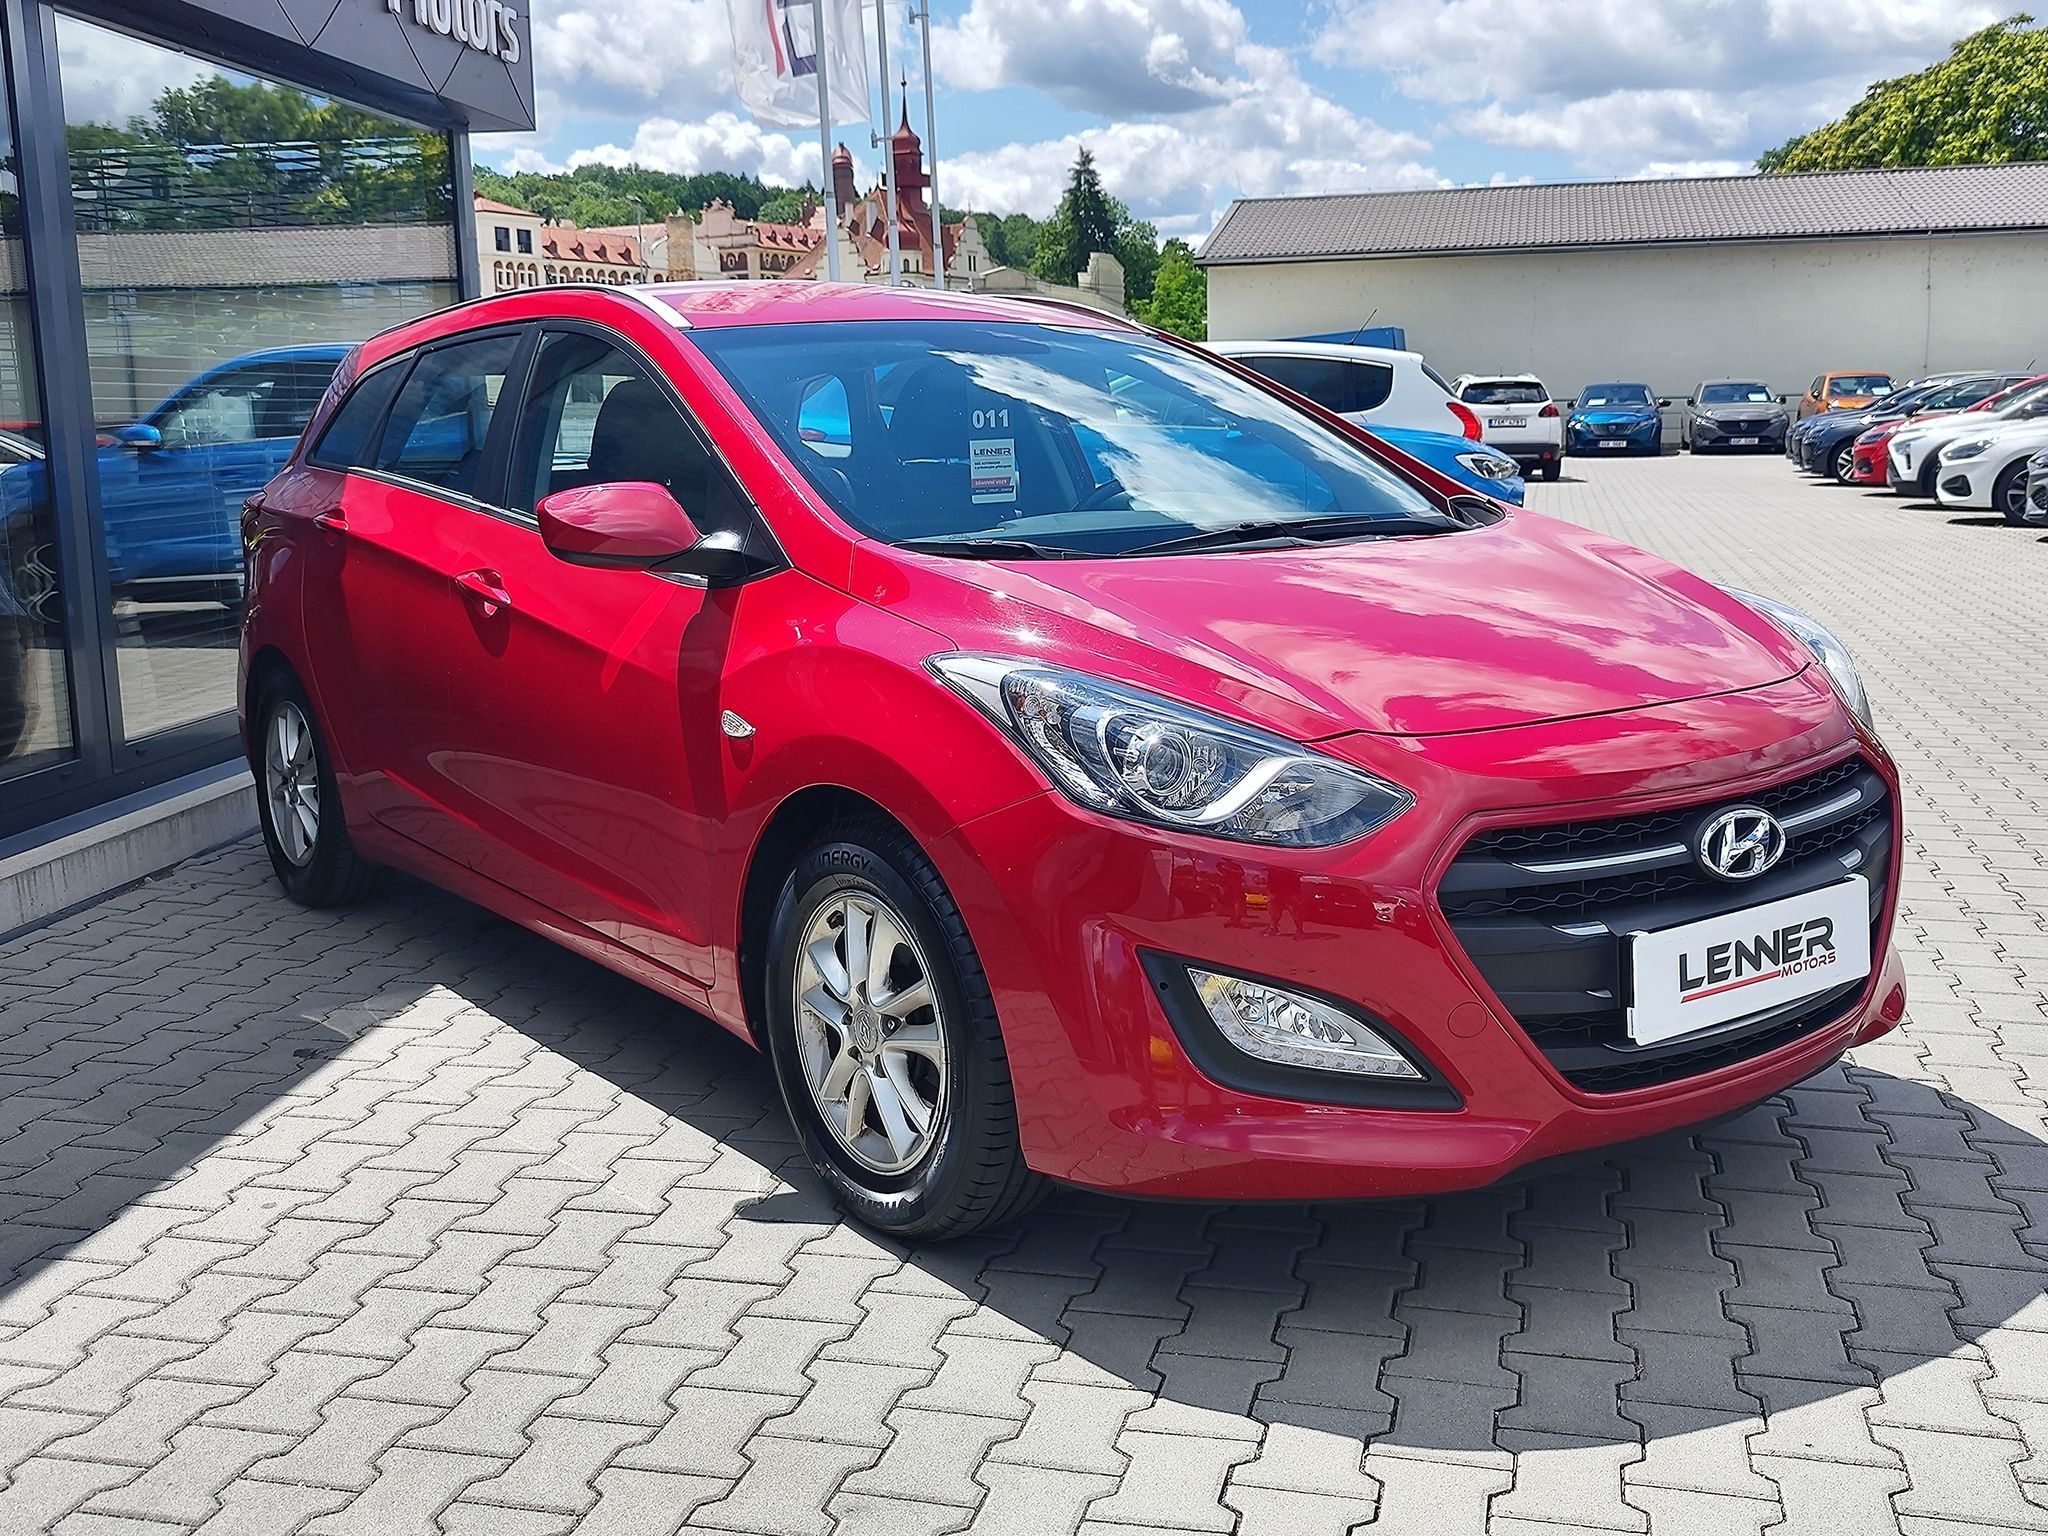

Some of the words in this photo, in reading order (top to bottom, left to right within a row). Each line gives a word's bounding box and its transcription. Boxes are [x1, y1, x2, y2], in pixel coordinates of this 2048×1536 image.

[972, 409, 1009, 429] 011
[973, 447, 1012, 457] LENNER
[1679, 916, 1836, 993] LENNER
[1780, 950, 1836, 979] MOTORS
